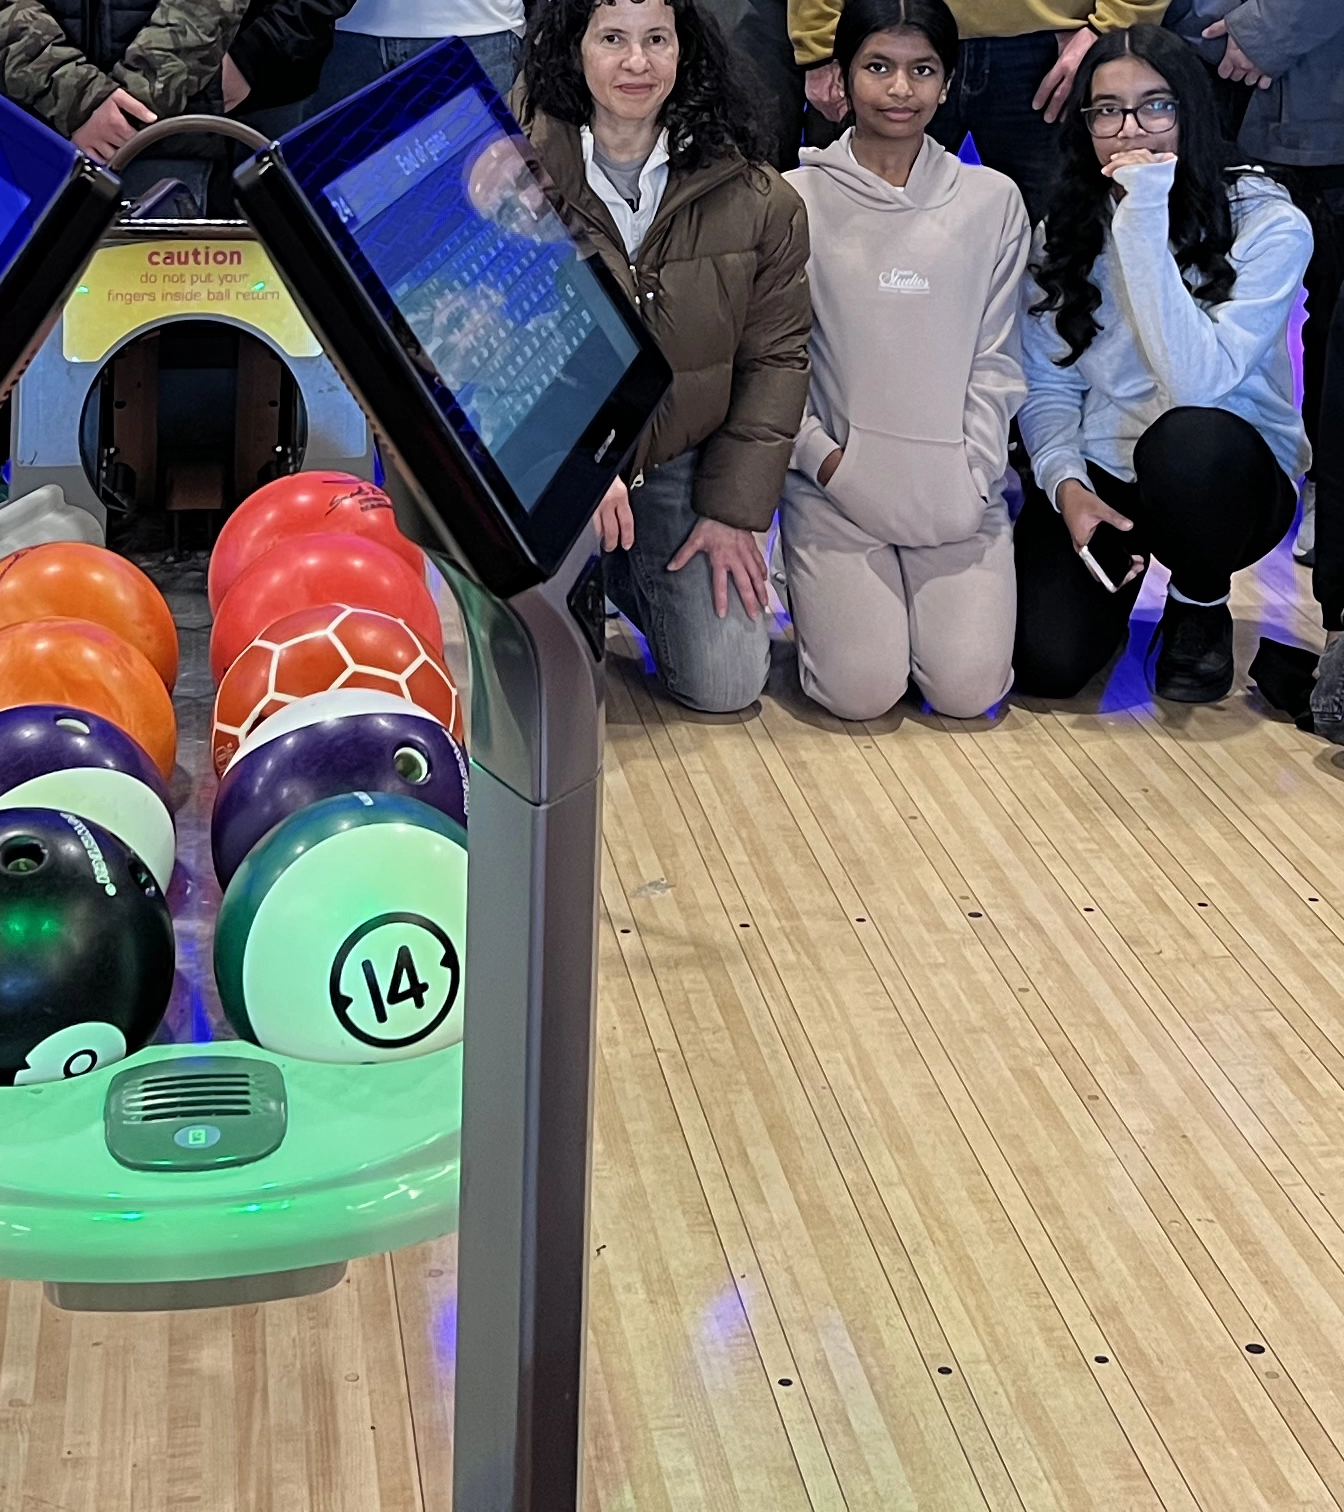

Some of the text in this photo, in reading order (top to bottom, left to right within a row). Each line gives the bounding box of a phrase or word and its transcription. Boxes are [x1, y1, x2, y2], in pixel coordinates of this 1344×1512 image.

[147, 246, 243, 266] caution
[140, 272, 249, 286] do not put your
[107, 289, 280, 305] fingers inside ball return
[361, 945, 429, 1024] 14
